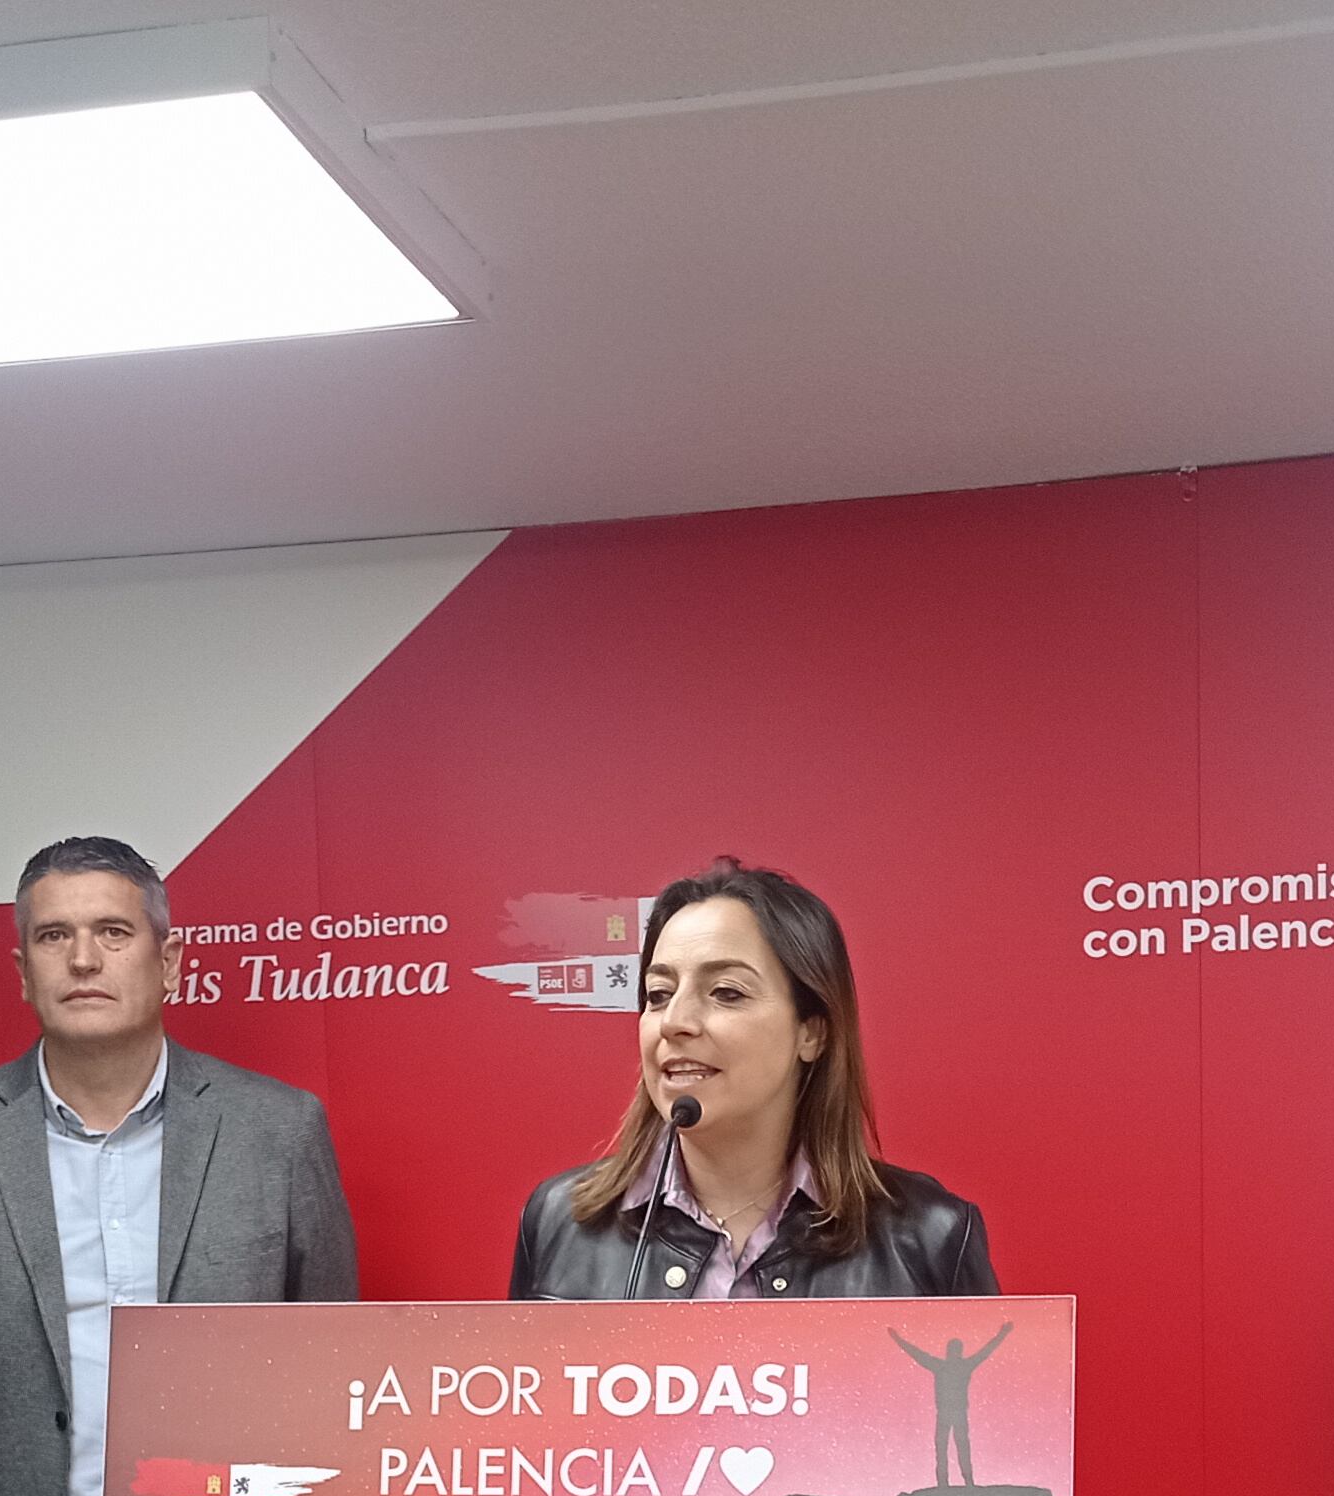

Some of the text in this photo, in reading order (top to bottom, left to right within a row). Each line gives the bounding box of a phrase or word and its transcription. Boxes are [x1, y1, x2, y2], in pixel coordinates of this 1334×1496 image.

[266, 916, 304, 942] de
[310, 911, 449, 941] Gobierno
[1082, 927, 1166, 959] con
[239, 951, 450, 1002] Tudanca
[539, 978, 564, 989] PSOE
[348, 1363, 810, 1431] ¡A POR TODAS!
